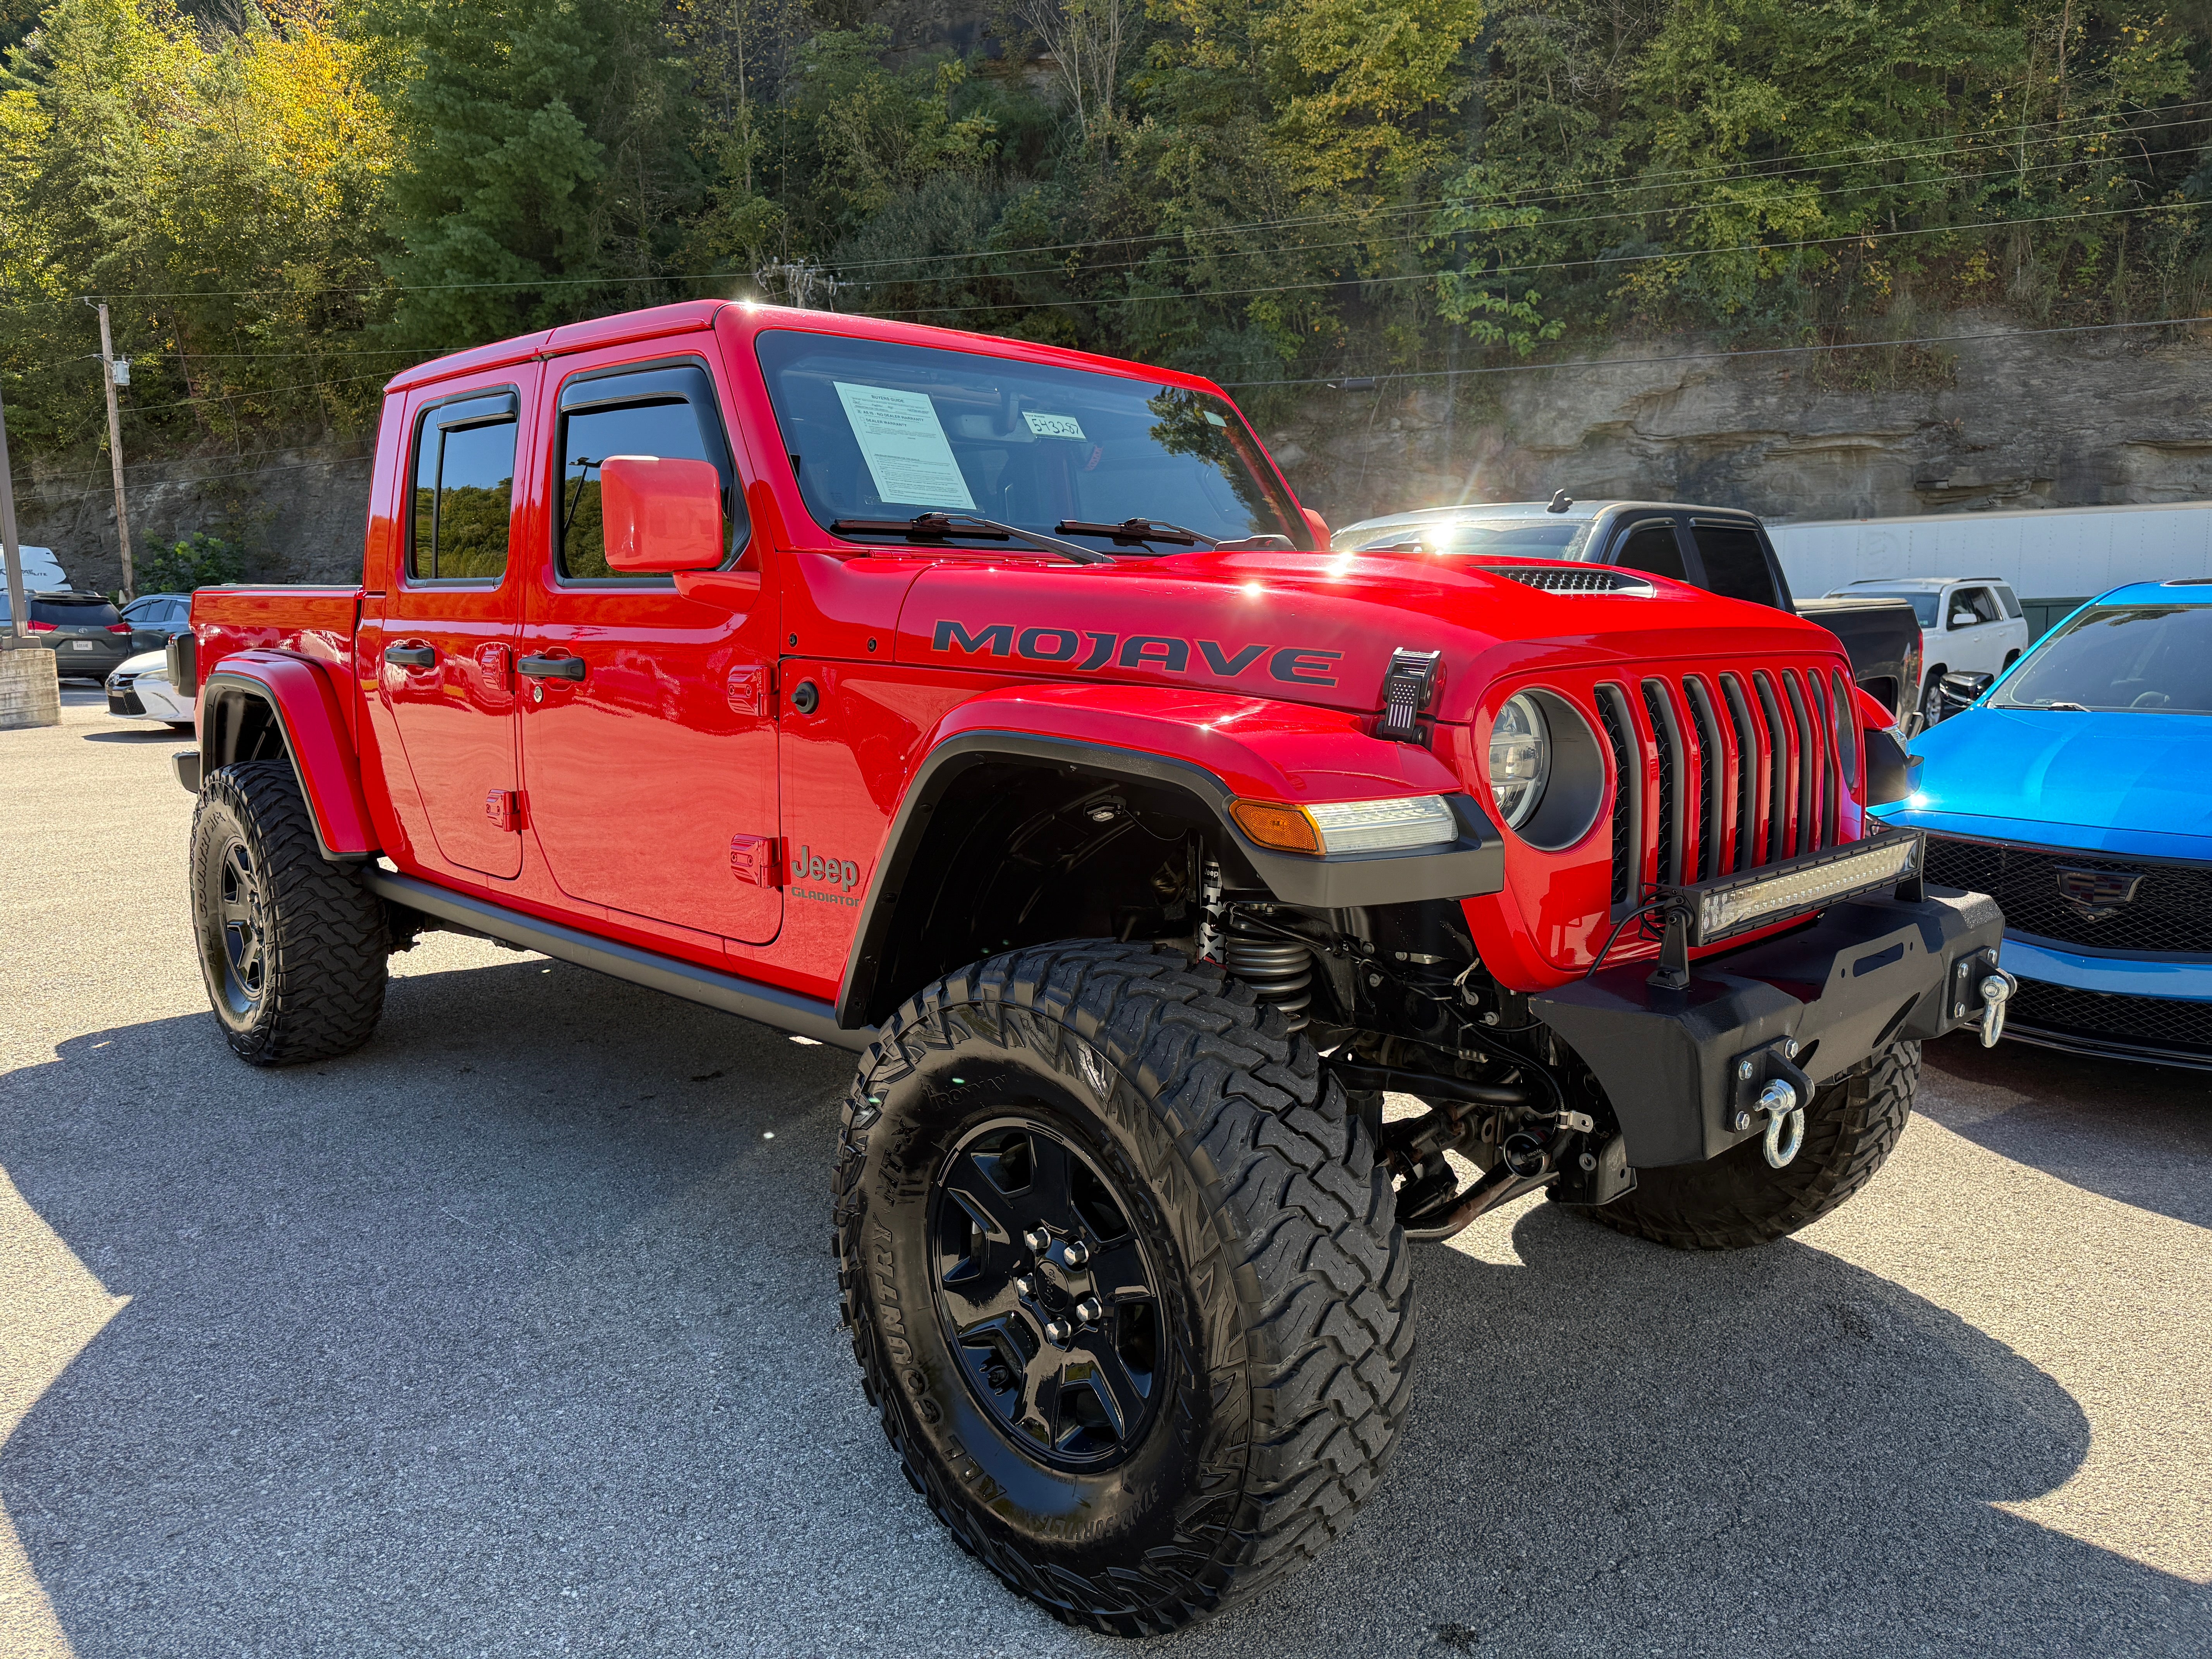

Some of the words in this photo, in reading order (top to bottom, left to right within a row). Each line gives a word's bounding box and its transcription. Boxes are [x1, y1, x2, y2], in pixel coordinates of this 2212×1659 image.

[1032, 419, 1079, 434] 543287
[931, 619, 1345, 688] MOJAVE
[791, 845, 860, 892] Jeep
[1204, 868, 1219, 878] Jeep
[873, 1211, 943, 1425] COUNTRY
[942, 1434, 1007, 1503] ALL
